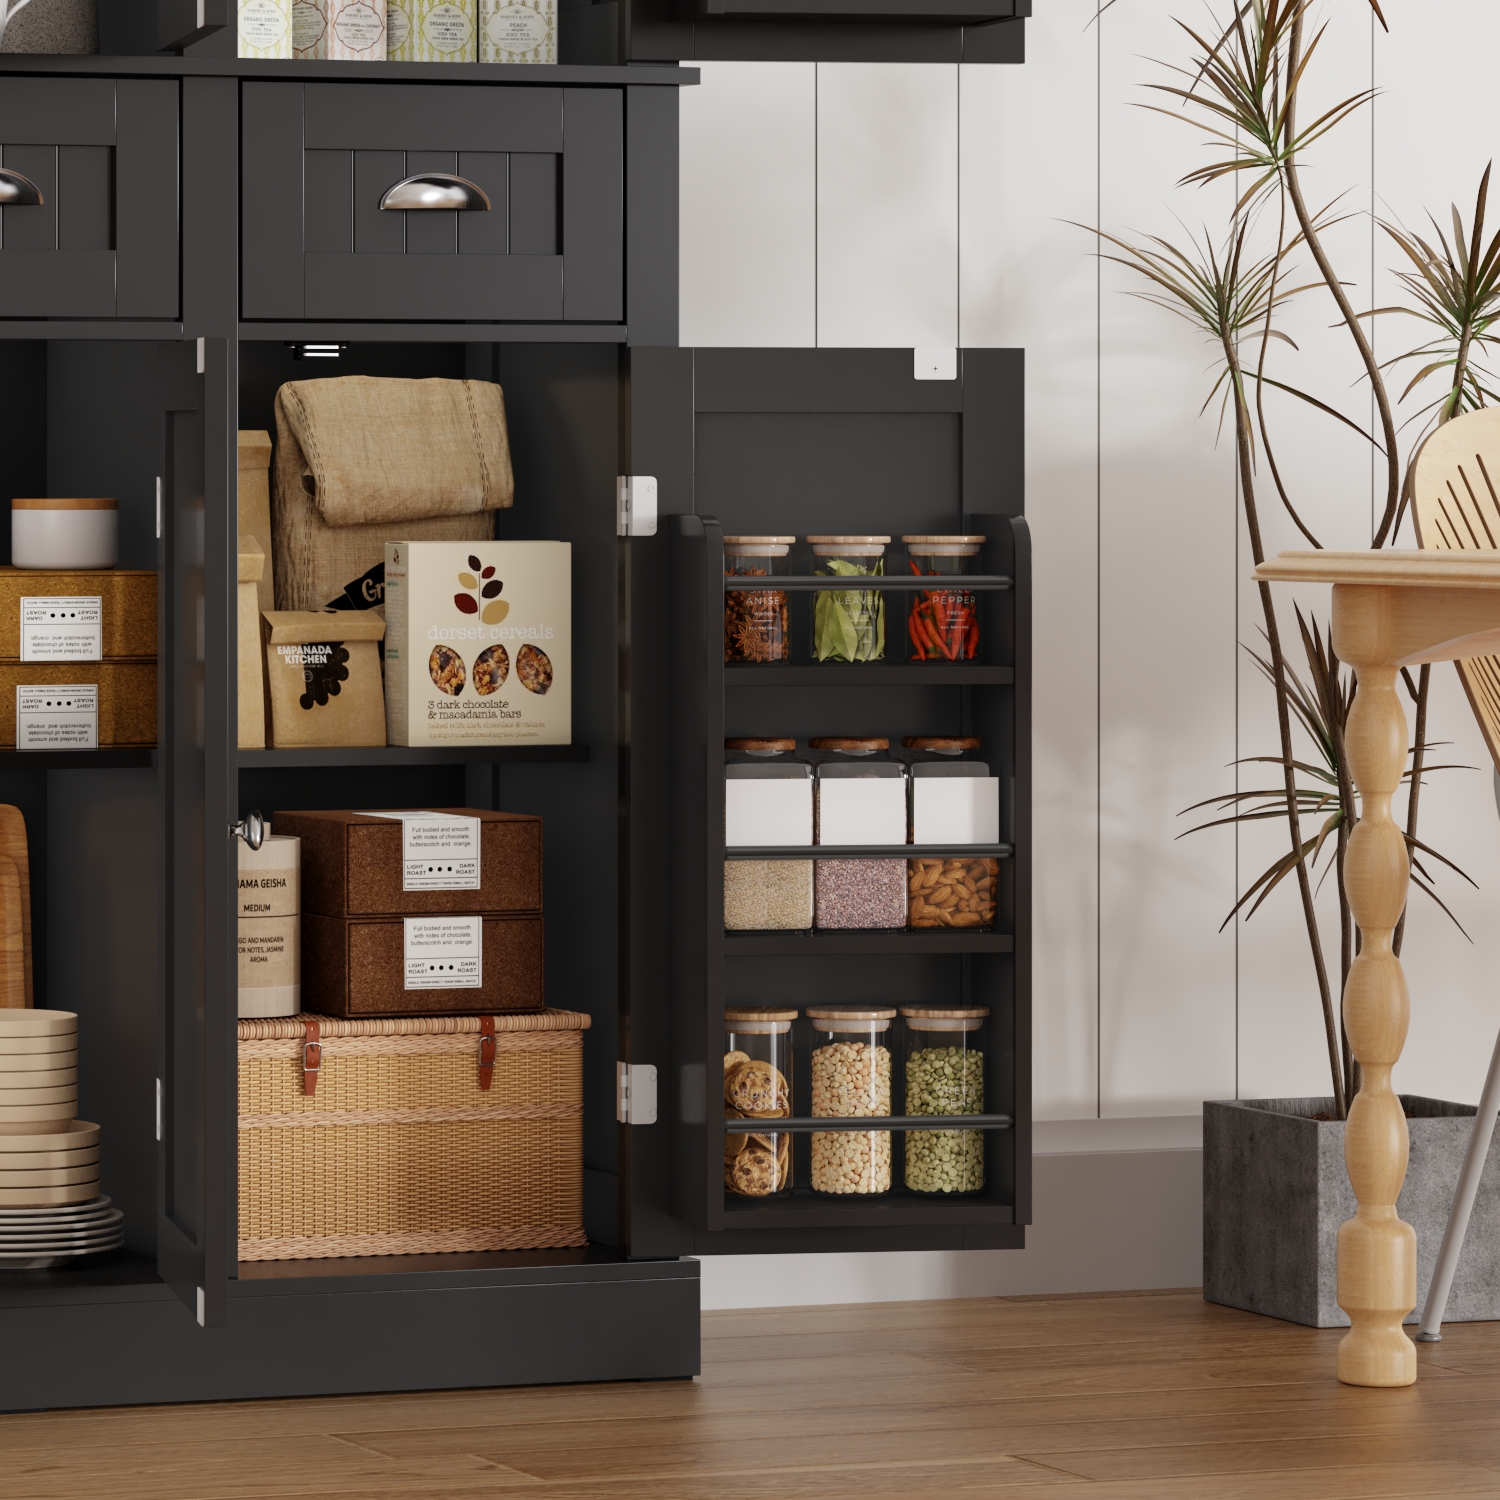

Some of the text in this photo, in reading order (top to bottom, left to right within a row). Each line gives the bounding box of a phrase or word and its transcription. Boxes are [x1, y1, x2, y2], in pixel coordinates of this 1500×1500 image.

[362, 578, 385, 602] Gr
[746, 596, 780, 605] ANISE
[838, 596, 879, 605] LEAVES
[932, 595, 976, 605] PEPPER
[428, 624, 554, 640] dorset cereals
[277, 645, 332, 655] EMPANADA
[285, 655, 327, 664] KITCHEN
[428, 700, 509, 709] 3 dark chocolate
[428, 709, 522, 719] & macadamia bars
[238, 878, 286, 889] AMA GEISHA
[244, 904, 271, 912] MEDIUM
[733, 1089, 790, 1098] CRUNCHY
[735, 1101, 787, 1110] COOKIES
